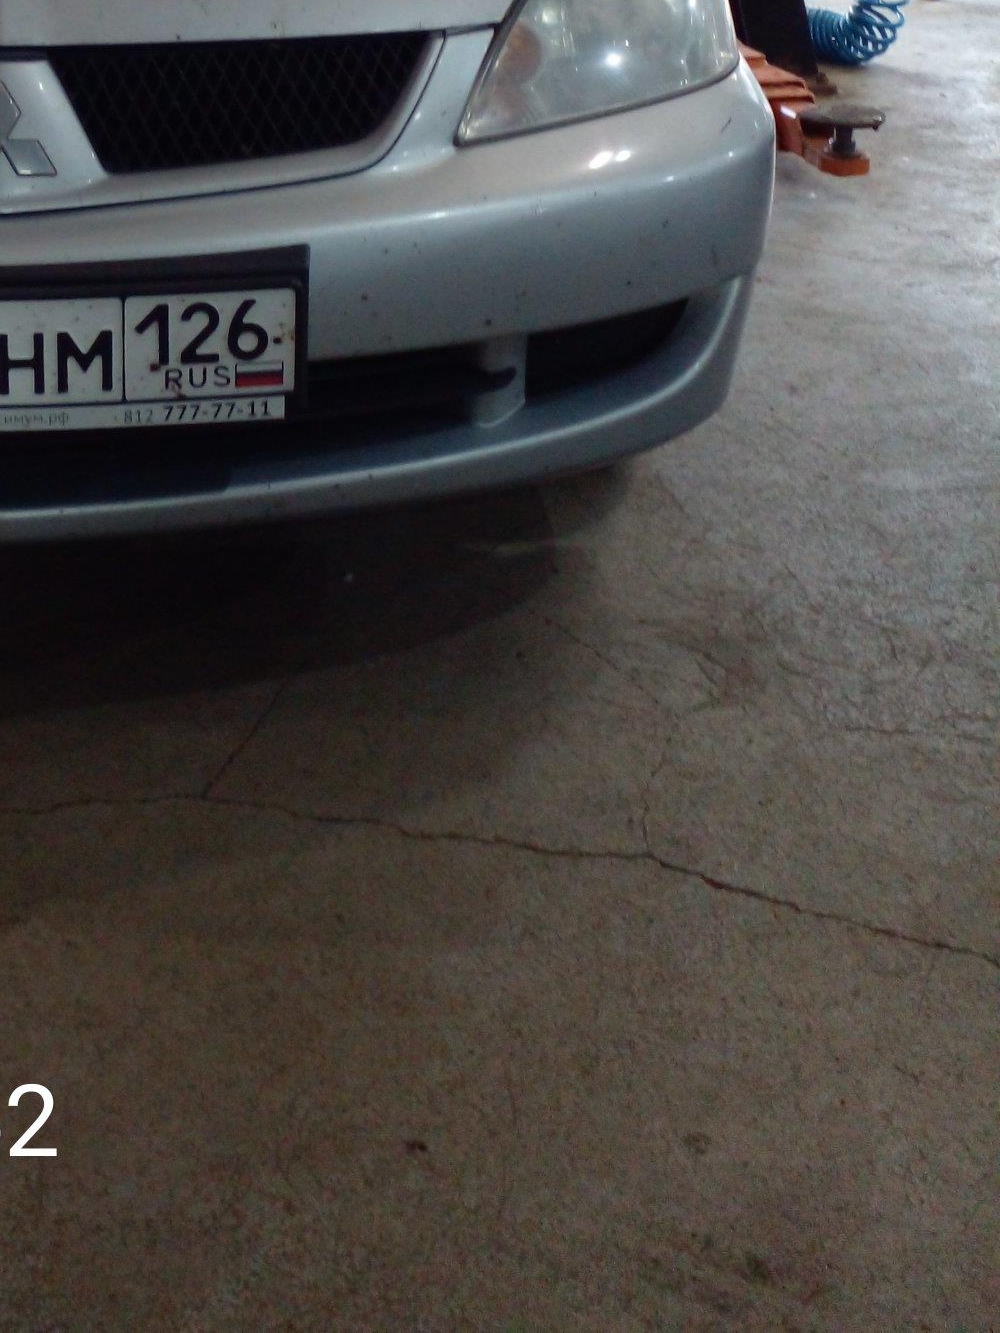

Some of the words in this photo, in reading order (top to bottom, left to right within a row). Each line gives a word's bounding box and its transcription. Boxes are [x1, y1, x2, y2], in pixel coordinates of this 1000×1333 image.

[135, 300, 269, 365] 126
[164, 366, 231, 389] RUS
[163, 400, 270, 421] 777-77-11
